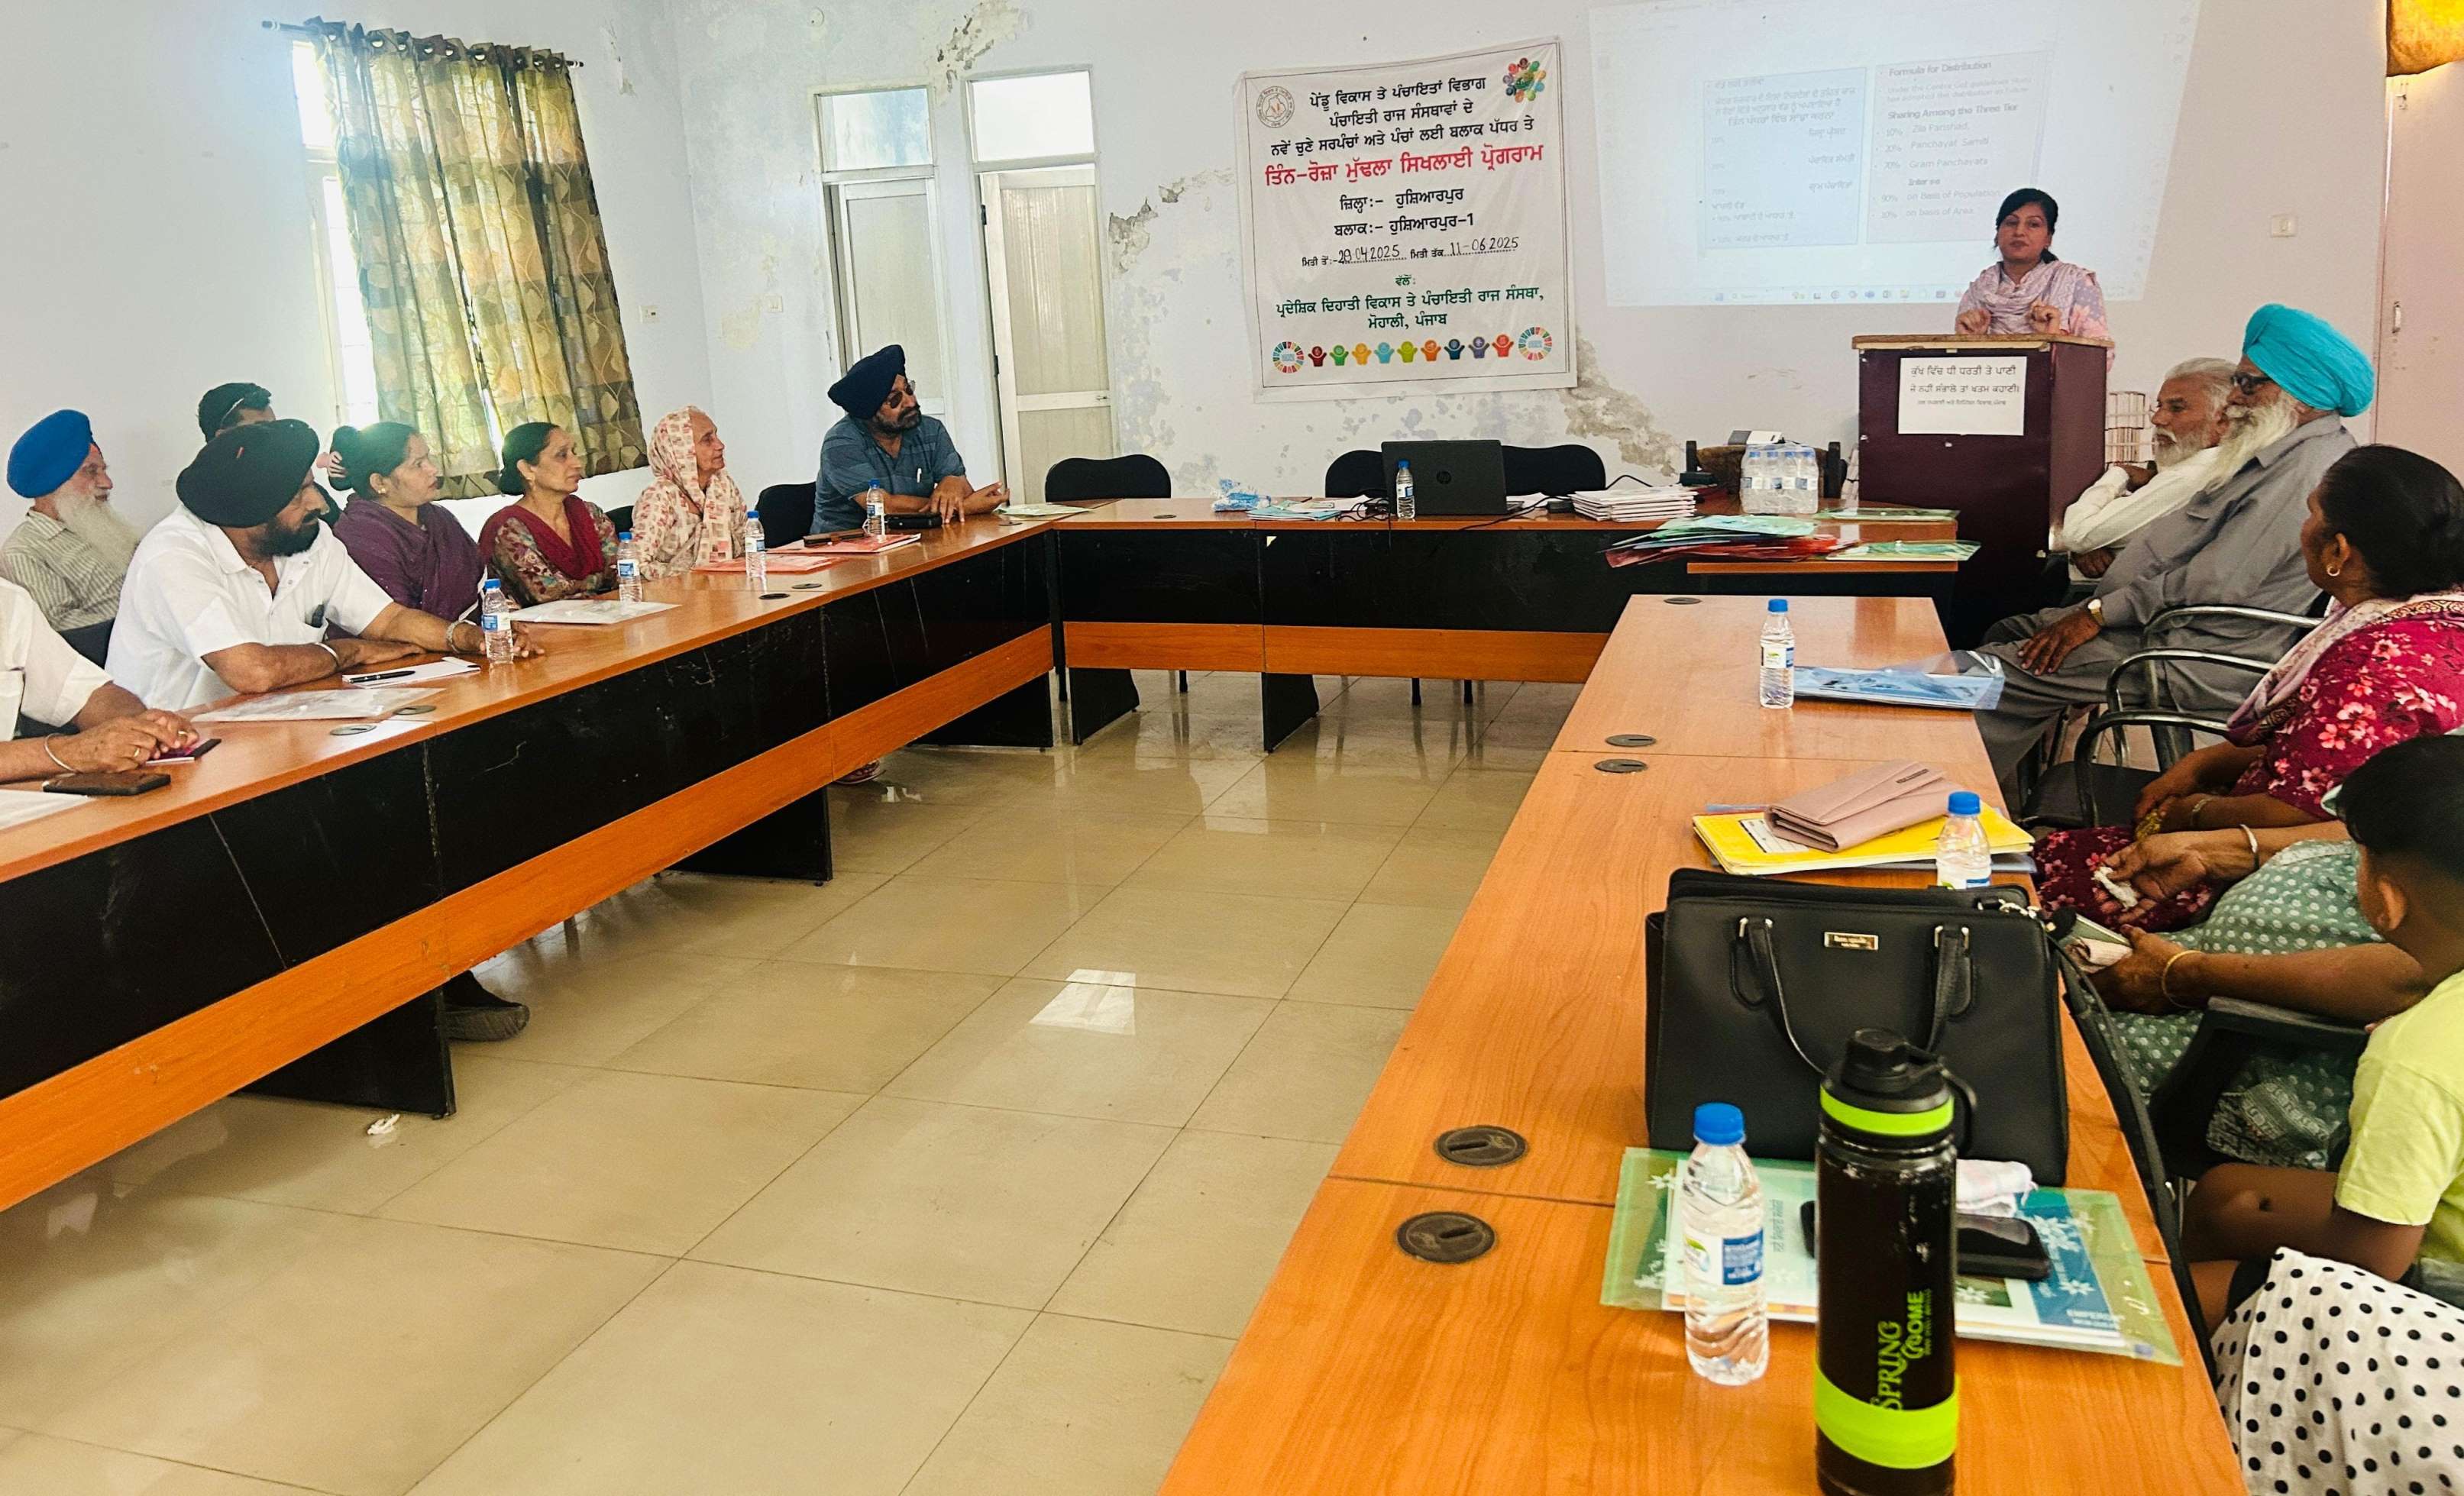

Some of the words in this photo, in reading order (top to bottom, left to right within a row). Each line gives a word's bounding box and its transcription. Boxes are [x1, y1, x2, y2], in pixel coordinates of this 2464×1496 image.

[1889, 66, 1925, 76] Formula
[1927, 63, 1939, 74] for
[1942, 61, 1992, 73] Distribution
[1309, 92, 1330, 111] ਪੇਂਡੂ
[1336, 89, 1372, 105] ਵਿਕਾਸ
[1377, 86, 1387, 100] ਤੇ
[1392, 80, 1443, 98] ਪੰਚਾਇਤਾਂ
[1448, 77, 1486, 92] ਵਿਭਾਗ
[1330, 108, 1378, 128] ਪੰਚਾਇਤੀ
[1383, 109, 1405, 121] ਰਾਜ
[1411, 100, 1457, 119] ਸੰਸਥਾਵਾਂ
[1463, 98, 1473, 114] ਦੇ
[1922, 108, 1955, 118] Among
[1958, 105, 1973, 115] the
[1976, 104, 2000, 113] Three
[1271, 141, 1291, 156] ਨਵੇਂ
[1295, 137, 1314, 156] ਚੁਣੇ
[1319, 133, 1359, 150] ਸਰਪੰਚਾਂ
[1364, 130, 1386, 146] ਅਤੇ
[1391, 128, 1414, 144] ਪੰਚਾਂ
[1419, 124, 1444, 141] ਲਈ
[1450, 122, 1484, 138] ਬਲਾਕ
[1489, 118, 1518, 134] ਪੱਧਰ
[1524, 115, 1534, 131] ਤੇ
[1265, 160, 1338, 186] ਤਿੰਨ-ਰੋਜ਼ਾ
[1345, 157, 1392, 183] ਮੁੱਢਲਾ
[1400, 146, 1473, 173] ਸਿਖਲਾਈ
[1481, 144, 1544, 170] ਪ੍ਰੋਗਰਾਮ
[1909, 160, 1935, 169] Gram
[1395, 188, 1464, 208] ਹੁਸ਼ਿਆਰਪੁਰ
[1389, 212, 1473, 234] ਹੁਸ਼ਿਆਰਪੁਰ-1
[1302, 257, 1318, 267] ਮਿਤੀ
[1410, 249, 1428, 260] ਮਿਤੀ
[1276, 299, 1317, 318] ਪ੍ਰਦੇਸ਼ਿਕ
[1321, 296, 1360, 312] ਦਿਹਾਤੀ
[1366, 295, 1401, 309] ਵਿਕਾਸ
[1406, 292, 1416, 306] ਤੇ
[1422, 288, 1472, 305] ਪੰਚਾਇਤੀ
[1478, 289, 1500, 302] ਰਾਜ
[1506, 284, 1544, 300] ਸੰਸਥਾ,
[1368, 312, 1408, 329] ਮੋਹਾਲੀ,
[1415, 311, 1447, 326] ਪੰਜਾਬ
[1959, 365, 1981, 375] ਧਰਤੀ
[1985, 365, 1992, 375] ਤੇ
[1995, 364, 2016, 375] ਪਾਣੀ
